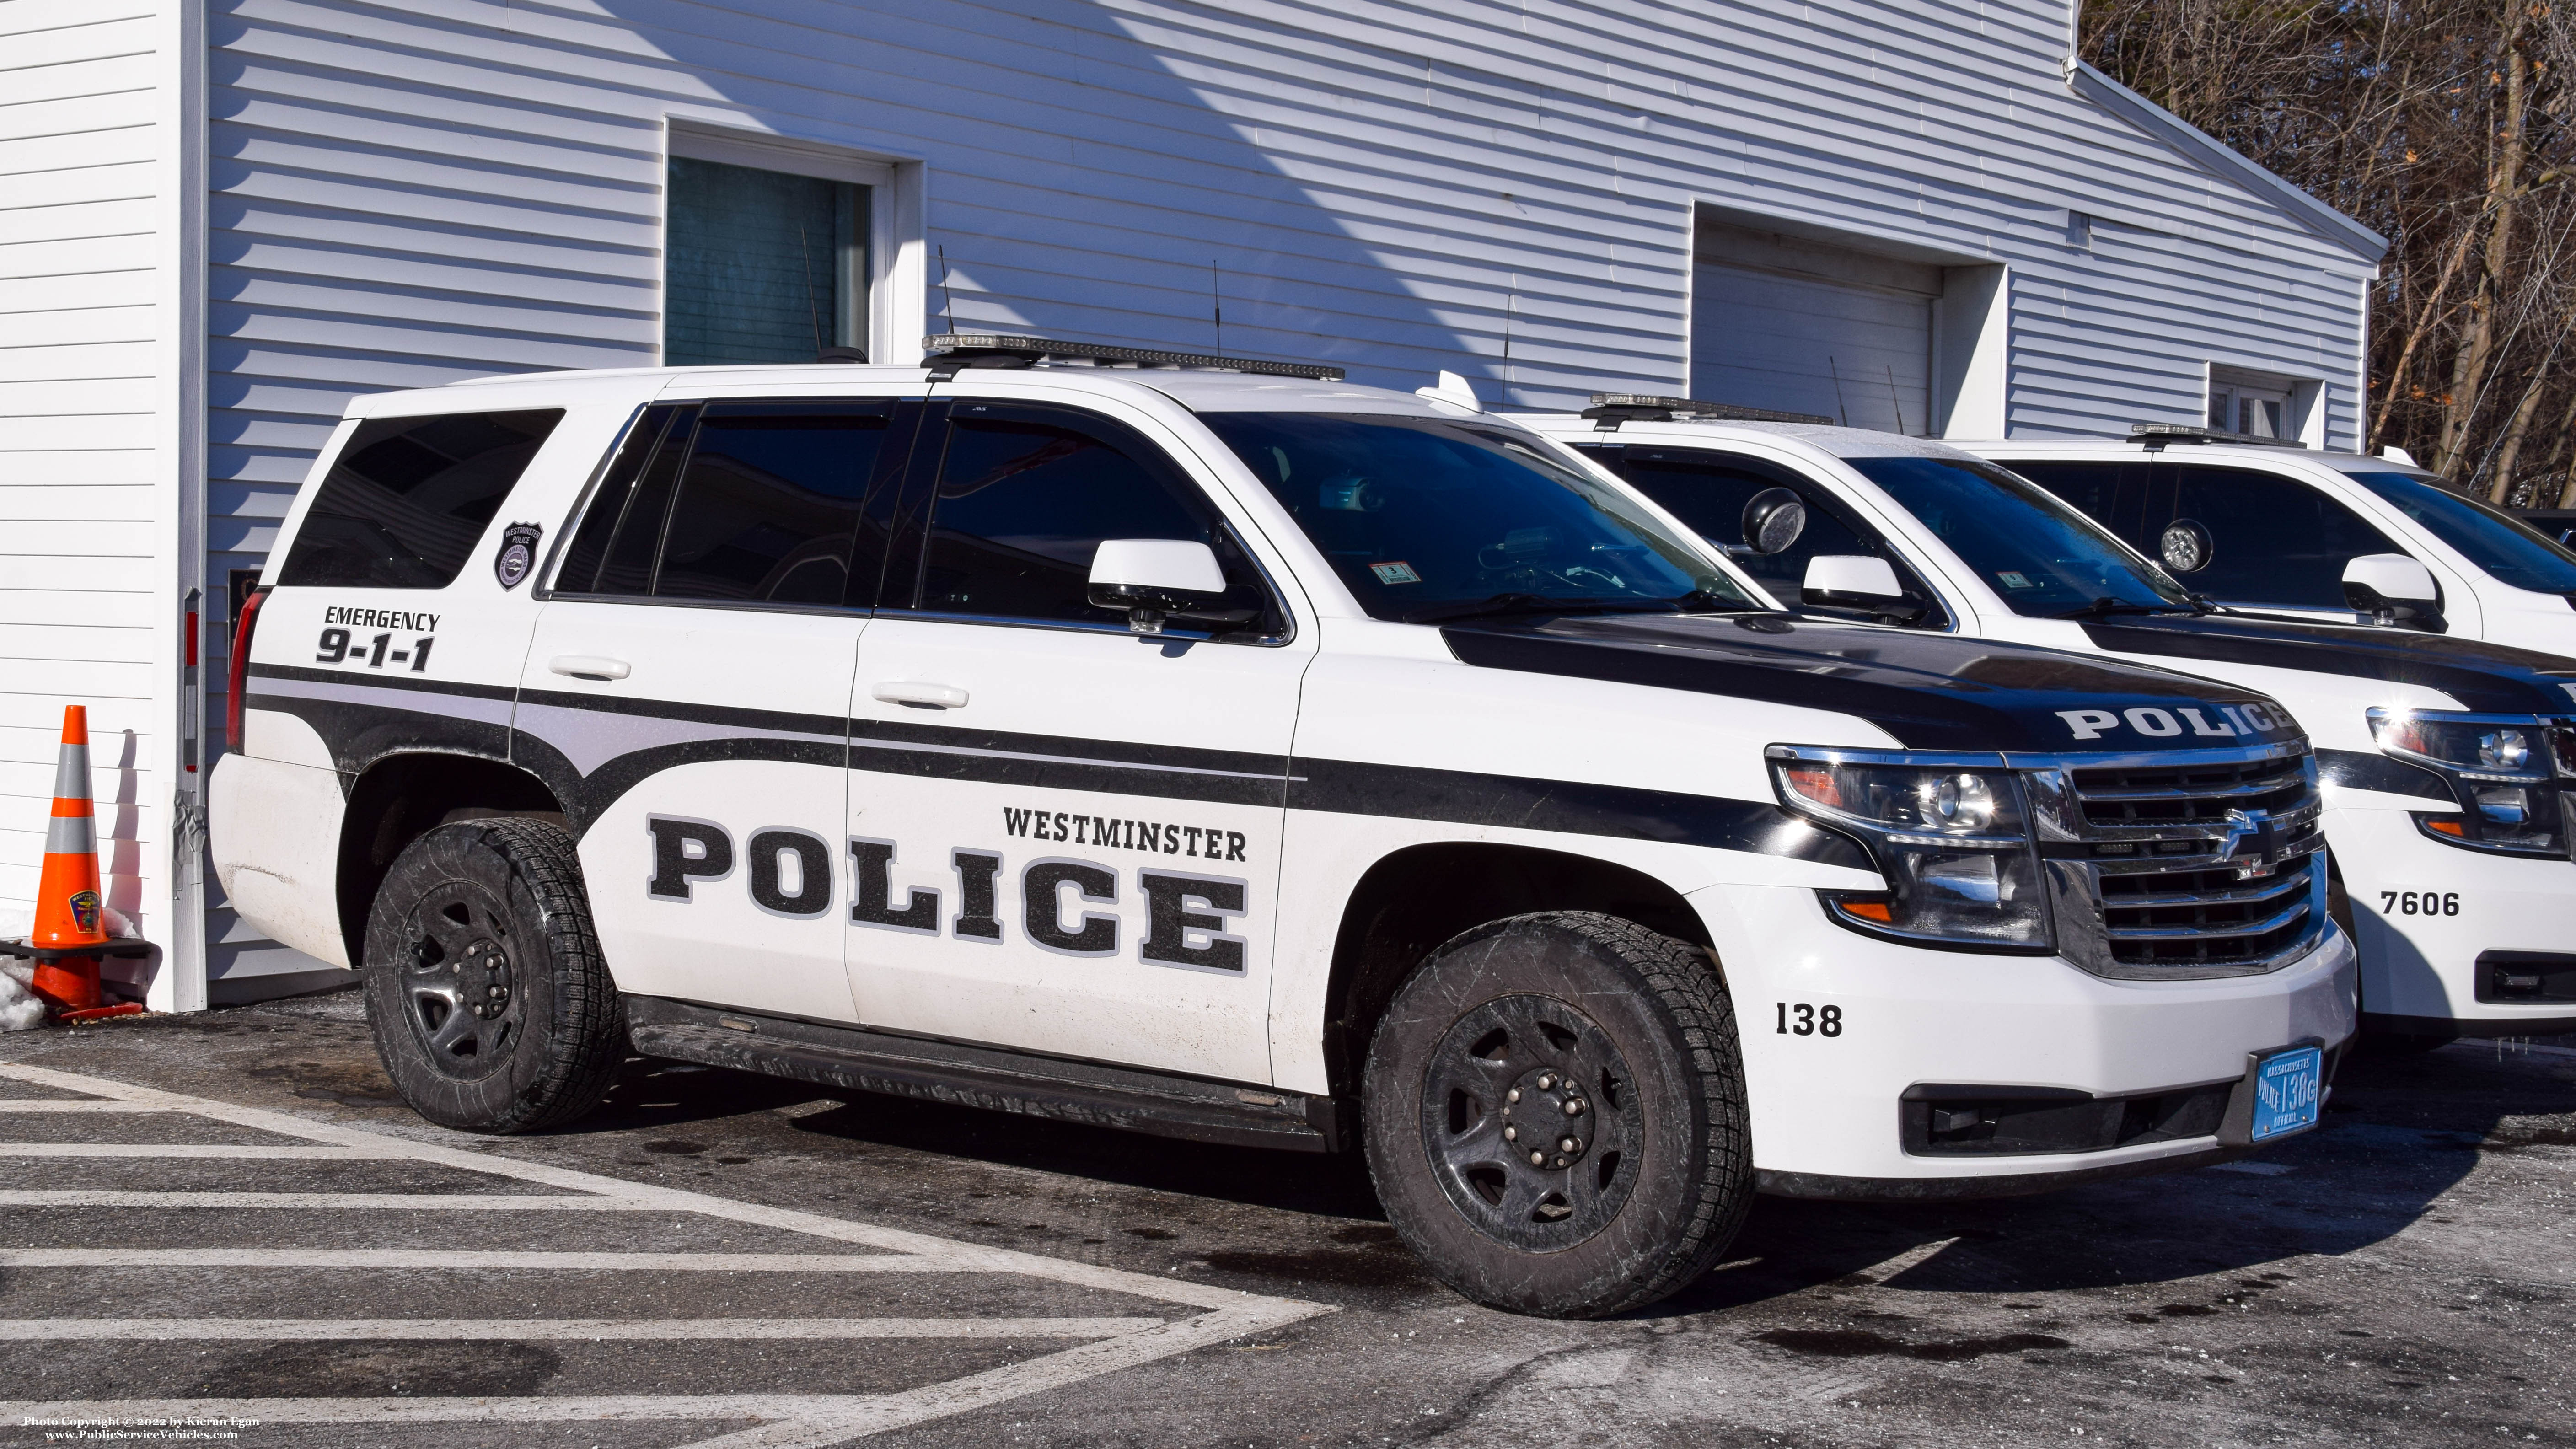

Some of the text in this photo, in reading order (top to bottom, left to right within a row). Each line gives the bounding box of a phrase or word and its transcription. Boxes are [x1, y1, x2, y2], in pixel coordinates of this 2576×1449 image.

[505, 526, 541, 540] WESTMINSTER
[325, 606, 440, 632] EMERGENCY
[316, 627, 436, 673] 9-1-1
[2055, 702, 2294, 740] POLICE
[1004, 807, 1246, 862] WESTMINSTER
[646, 812, 1249, 978] POLICE
[2381, 891, 2459, 916] 7606
[1776, 1002, 1842, 1037] 138
[2267, 1058, 2309, 1078] MASSACHUSETTS
[2259, 1076, 2280, 1113] POLICE
